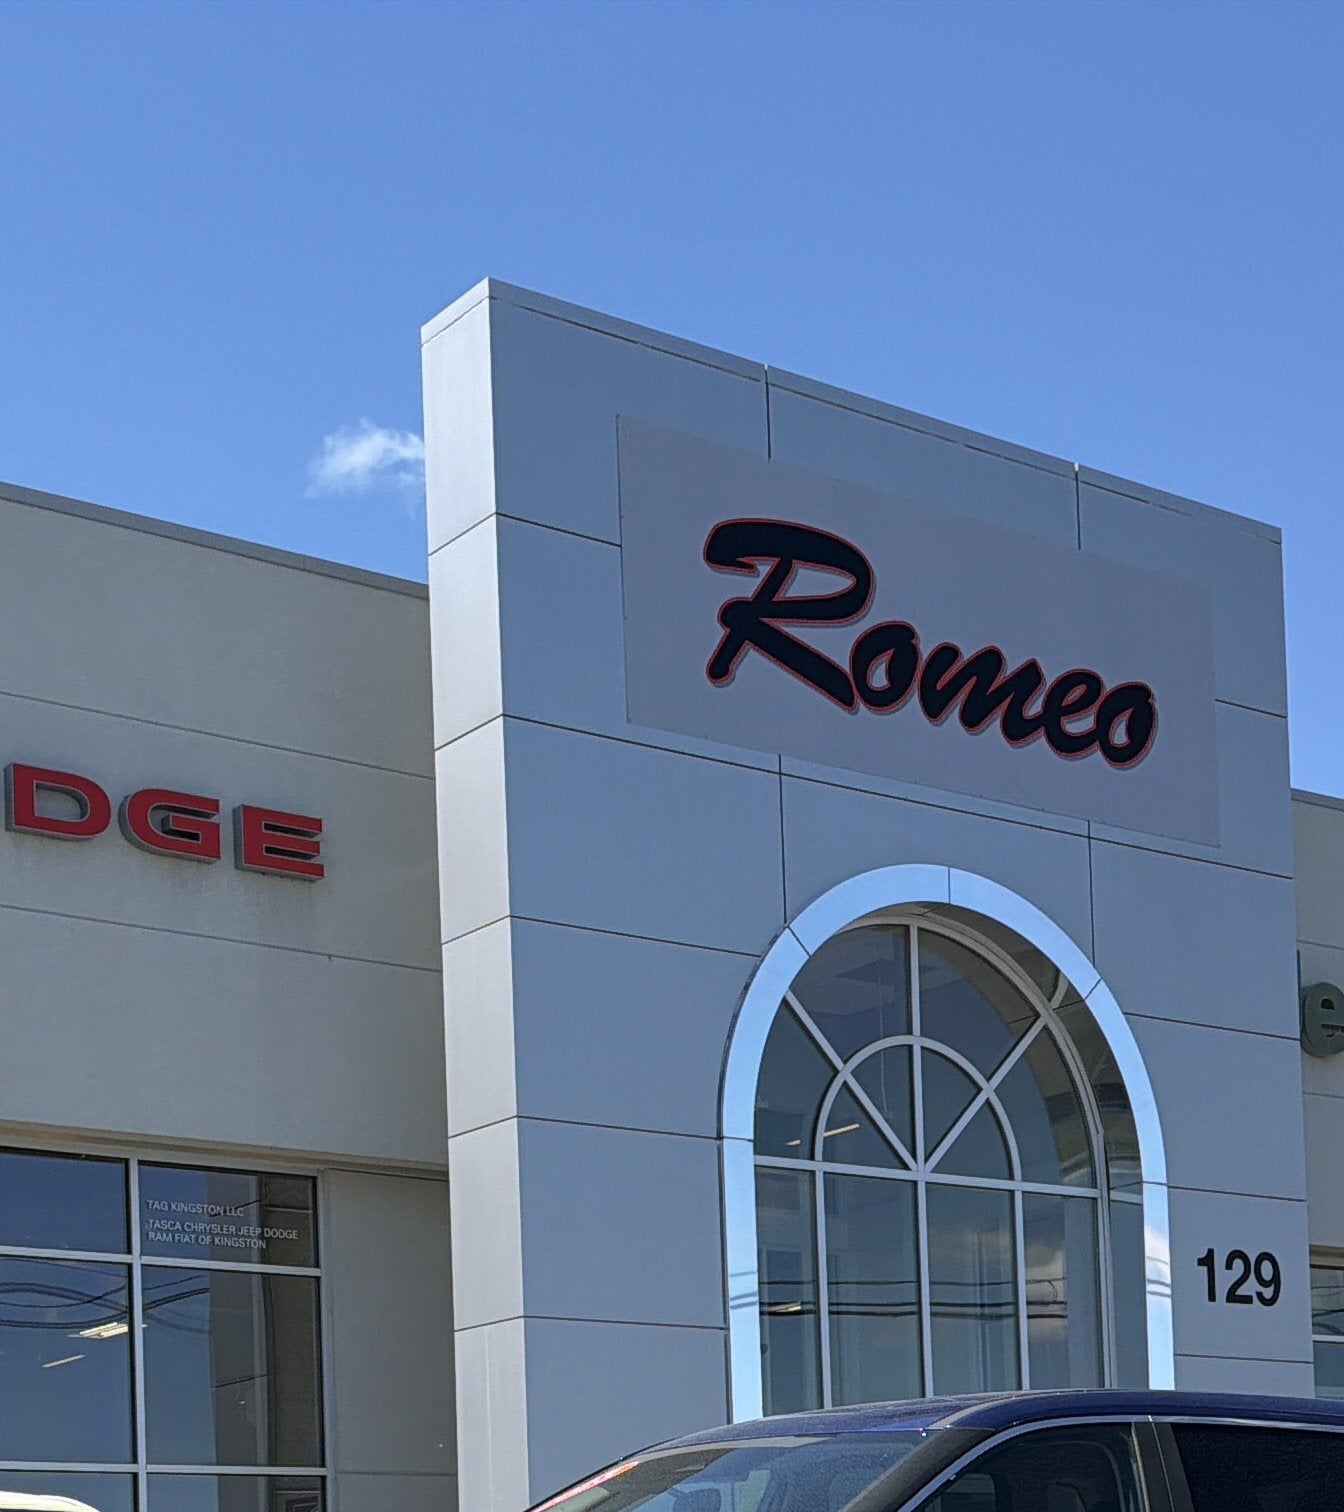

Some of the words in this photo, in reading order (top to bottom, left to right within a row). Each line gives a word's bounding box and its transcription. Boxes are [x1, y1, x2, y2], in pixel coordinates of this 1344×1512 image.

[704, 517, 1158, 770] Romeo
[147, 1199, 168, 1211] TAG
[170, 1202, 224, 1216] KINGSTON
[225, 1205, 245, 1217] LLC
[147, 1219, 183, 1231] TASCA
[184, 1222, 236, 1235] CHRYSLER
[238, 1226, 262, 1237] JEEP
[264, 1228, 299, 1239] DODGE
[148, 1231, 173, 1243] RAM
[175, 1233, 197, 1244] FIAT
[198, 1235, 213, 1246] OF
[214, 1236, 267, 1249] KINGSTON
[1196, 1248, 1282, 1307] 129
